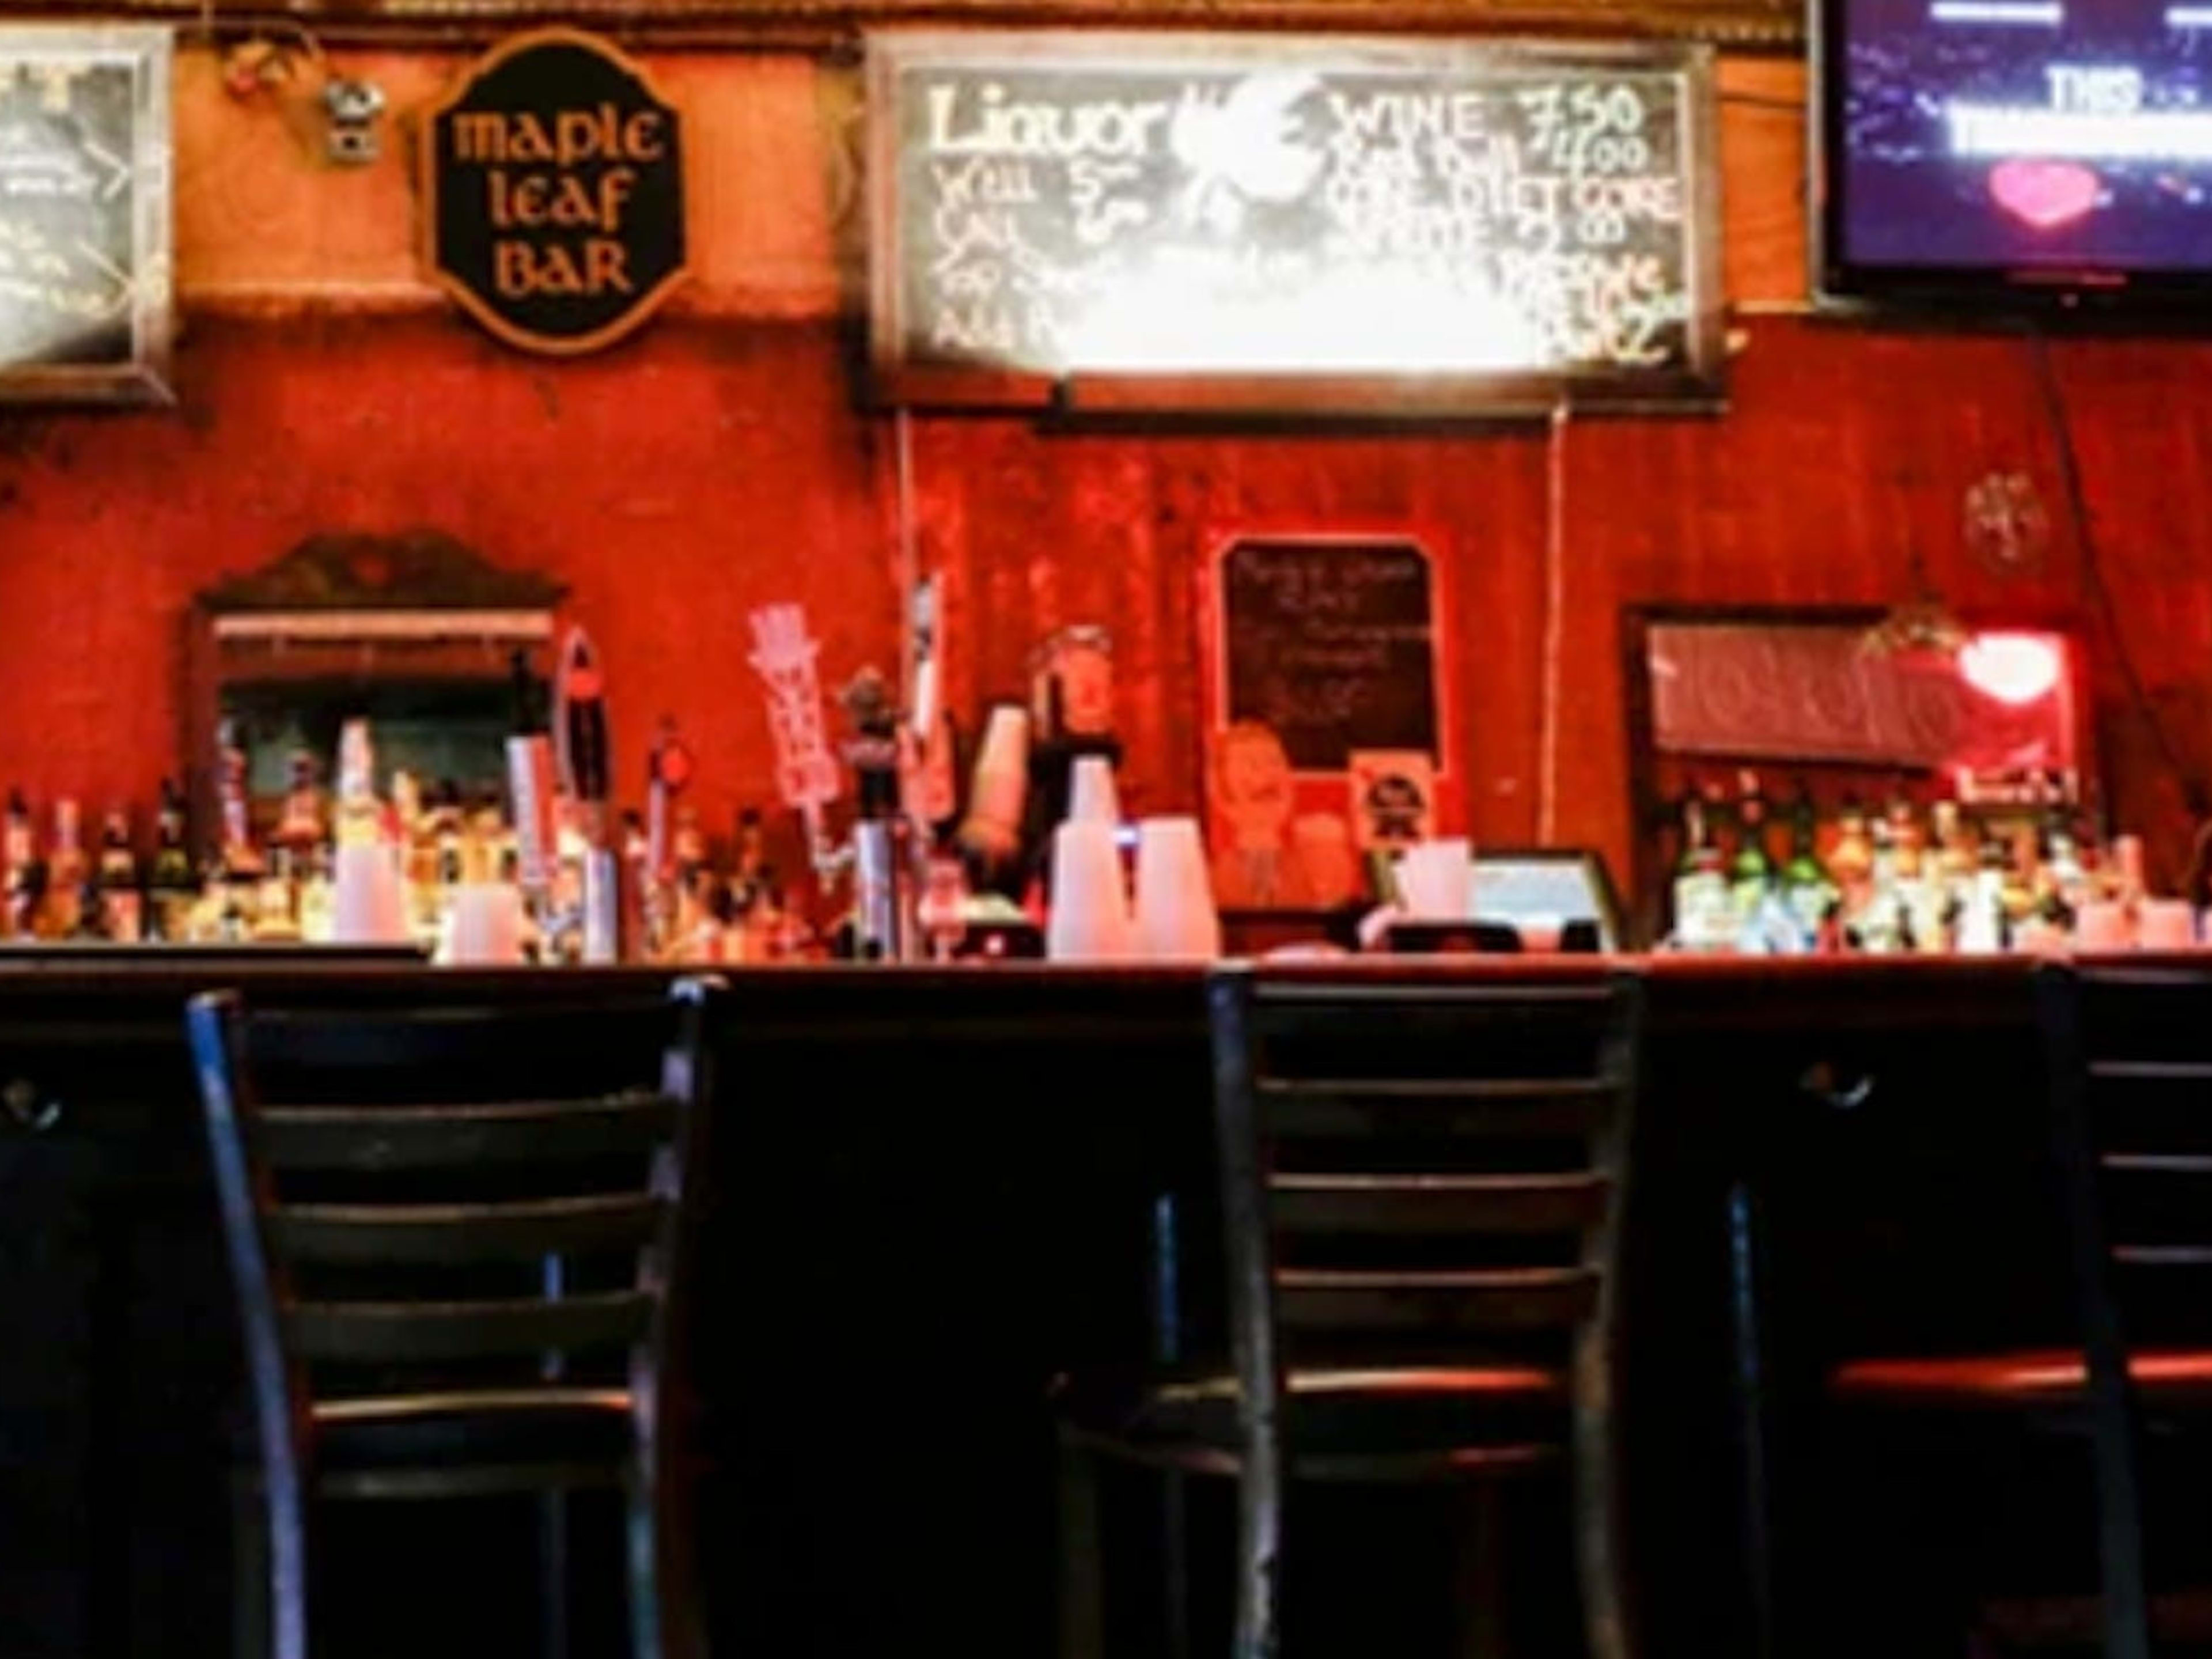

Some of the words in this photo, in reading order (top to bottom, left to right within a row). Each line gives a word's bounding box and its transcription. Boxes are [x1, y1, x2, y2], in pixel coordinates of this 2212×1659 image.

[929, 84, 1168, 157] Liquor
[1328, 91, 1491, 142] WINE
[495, 238, 635, 298] BAR
